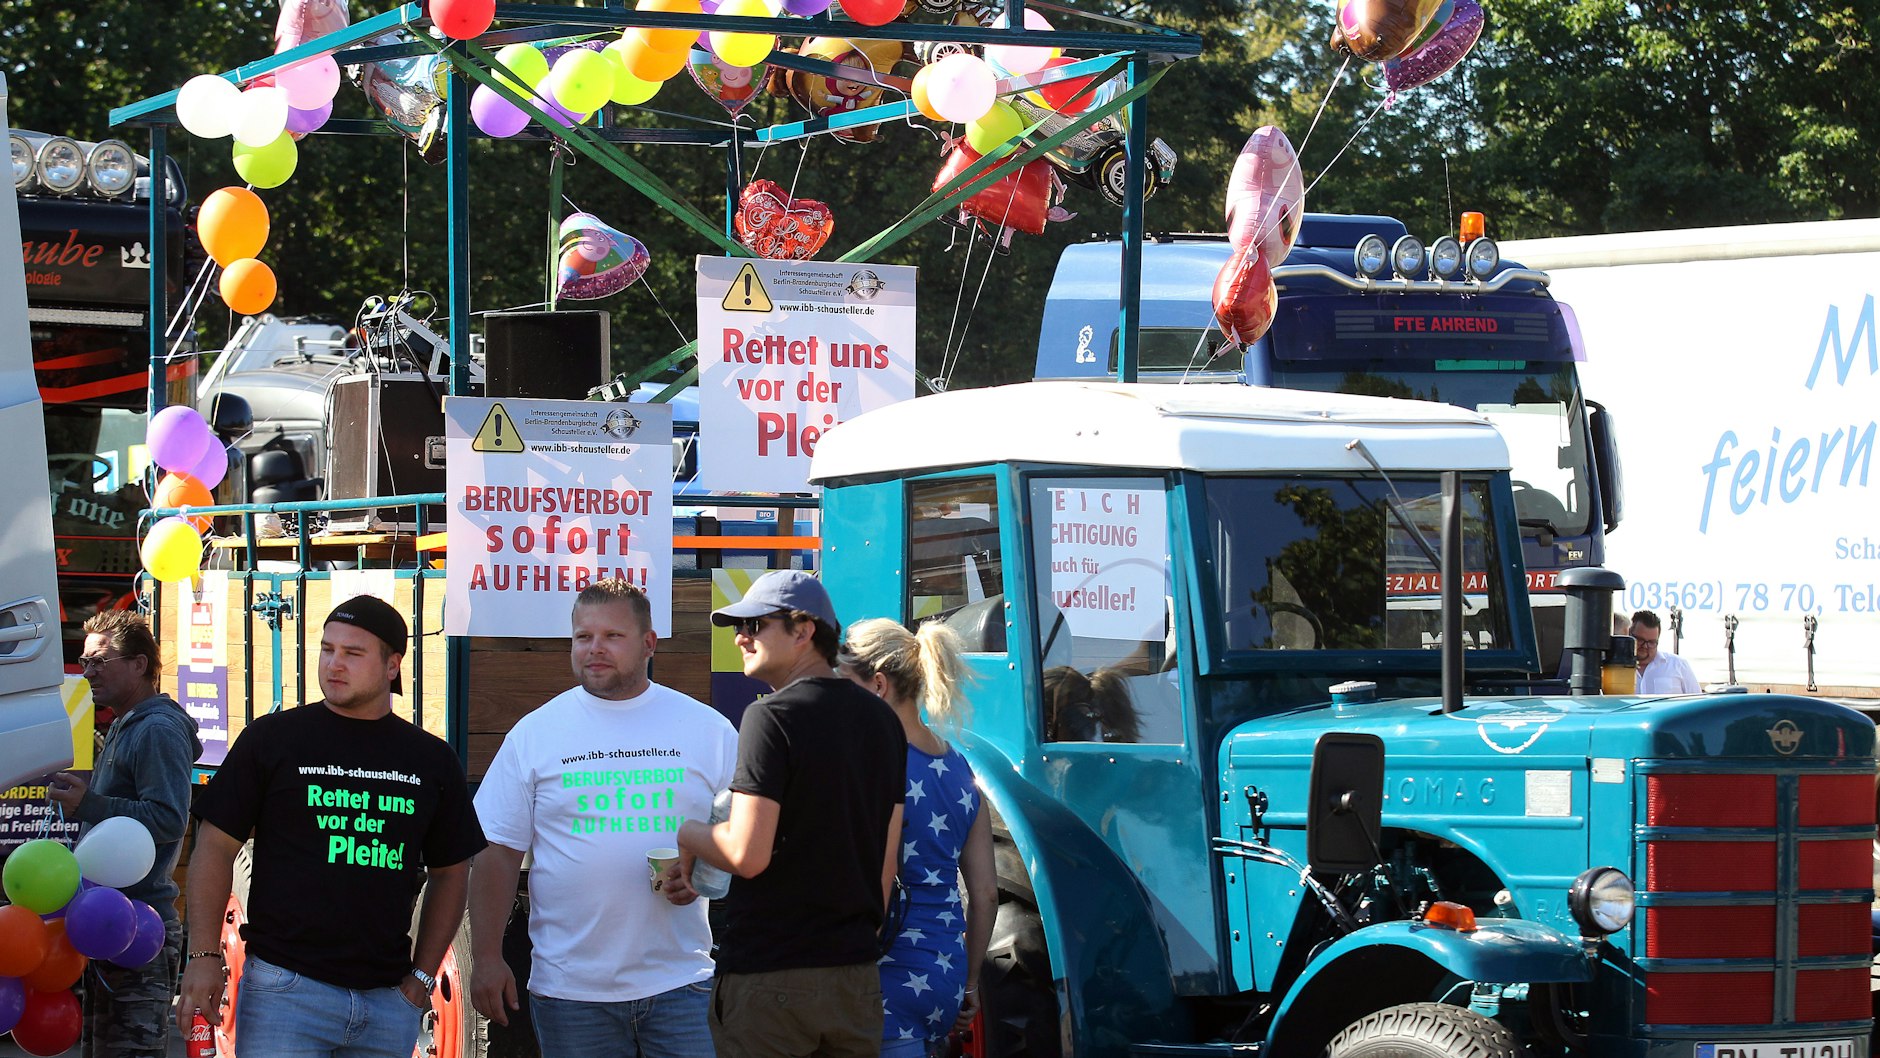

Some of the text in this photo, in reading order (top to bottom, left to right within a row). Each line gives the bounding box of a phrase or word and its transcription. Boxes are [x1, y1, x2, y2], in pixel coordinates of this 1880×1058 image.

[773, 278, 844, 288] Berlin-Brandenburgischer
[779, 269, 844, 279] Interessengemeinschaft
[798, 288, 832, 297] Schausteller
[779, 303, 875, 316] www.ibb-schausteller.de
[1393, 316, 1498, 333] FTE AHREND
[722, 328, 889, 370] Rettet uns
[737, 371, 842, 404] vor der
[525, 418, 598, 428] Berlin-Brandenburgischer
[530, 409, 598, 418] Interessengemeinschaft
[551, 427, 585, 436] Schausteller
[530, 442, 631, 455] www.ibb-schausteller.de
[1699, 420, 1878, 535] feiern
[465, 485, 653, 516] BERUFSVERBOT
[486, 514, 631, 556] sofort
[1835, 536, 1880, 560] Sch
[1081, 557, 1100, 575] für
[1052, 585, 1136, 611] usteller!
[1621, 580, 1723, 613] (03562)
[1735, 583, 1769, 611] 78
[1780, 584, 1823, 616] 70,
[561, 747, 681, 765] www.ibb-schausteller.de
[298, 764, 421, 785] www.ibb-schausteller.de
[562, 767, 686, 789] BERUFSVERBOT
[307, 784, 415, 815] Rettet uns
[577, 787, 675, 812] sofort
[316, 812, 385, 834] vor der
[327, 835, 405, 870] Pleite!
